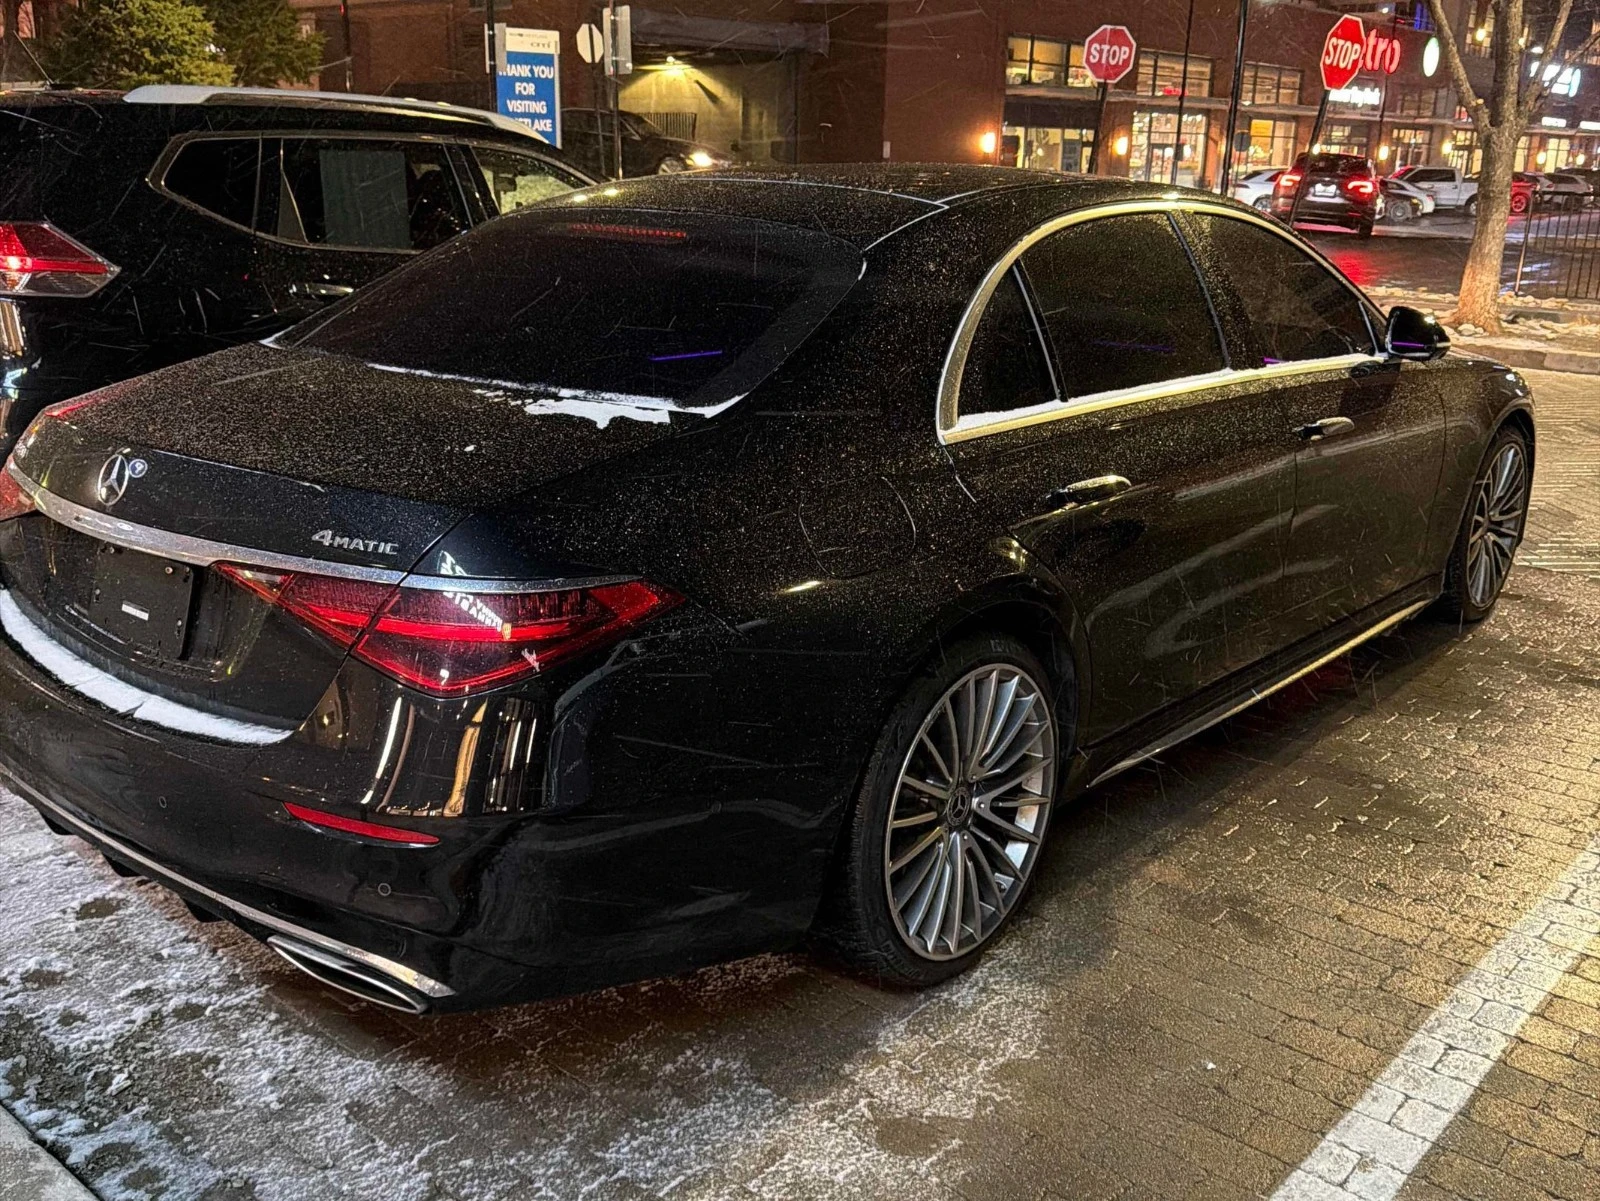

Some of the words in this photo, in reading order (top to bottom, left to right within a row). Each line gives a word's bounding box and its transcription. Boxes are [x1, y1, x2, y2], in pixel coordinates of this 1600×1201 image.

[1089, 43, 1130, 66] STOP
[1325, 37, 1362, 70] STOP
[1361, 29, 1401, 74] tro
[498, 64, 532, 78] HANK
[533, 65, 553, 79] YOU
[515, 82, 536, 95] FOR
[507, 99, 547, 114] VISITING
[311, 529, 399, 555] 4MATIC
